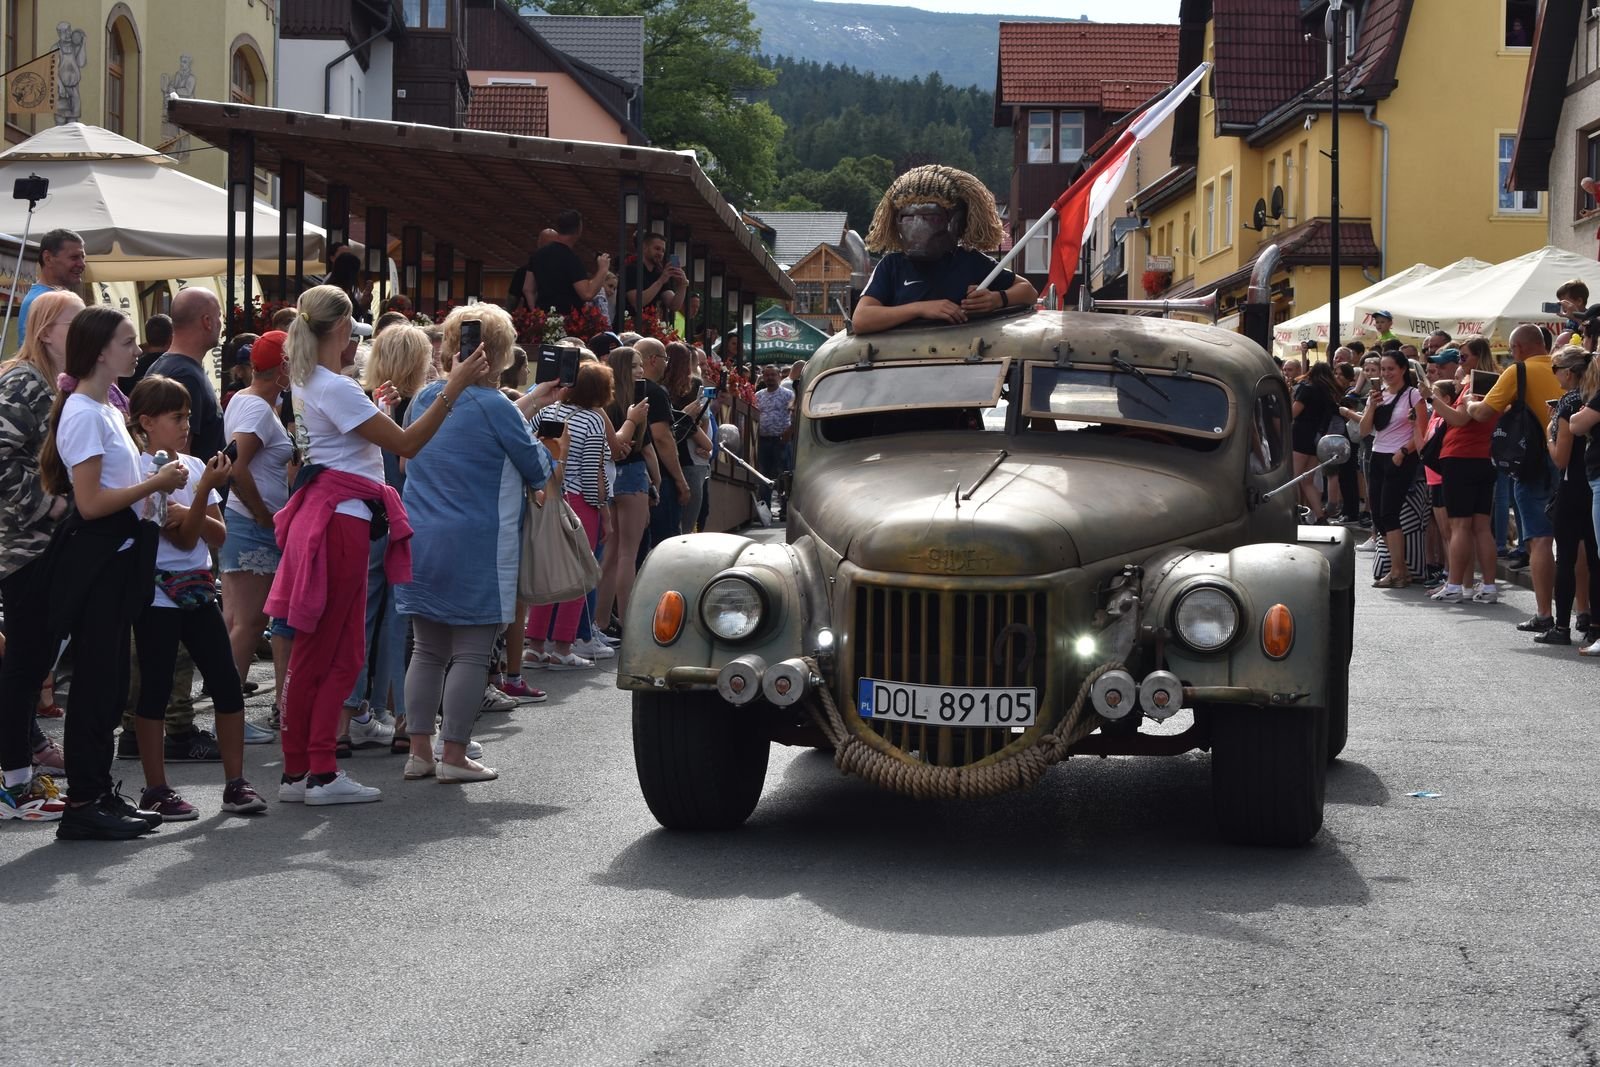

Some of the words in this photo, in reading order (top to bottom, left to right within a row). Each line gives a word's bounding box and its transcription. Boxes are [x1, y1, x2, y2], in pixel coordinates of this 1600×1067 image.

[1408, 319, 1440, 334] VERDE
[1457, 321, 1484, 335] TYSKIE
[861, 702, 871, 711] PL
[875, 685, 927, 720] DOL
[939, 692, 1031, 722] 89105
